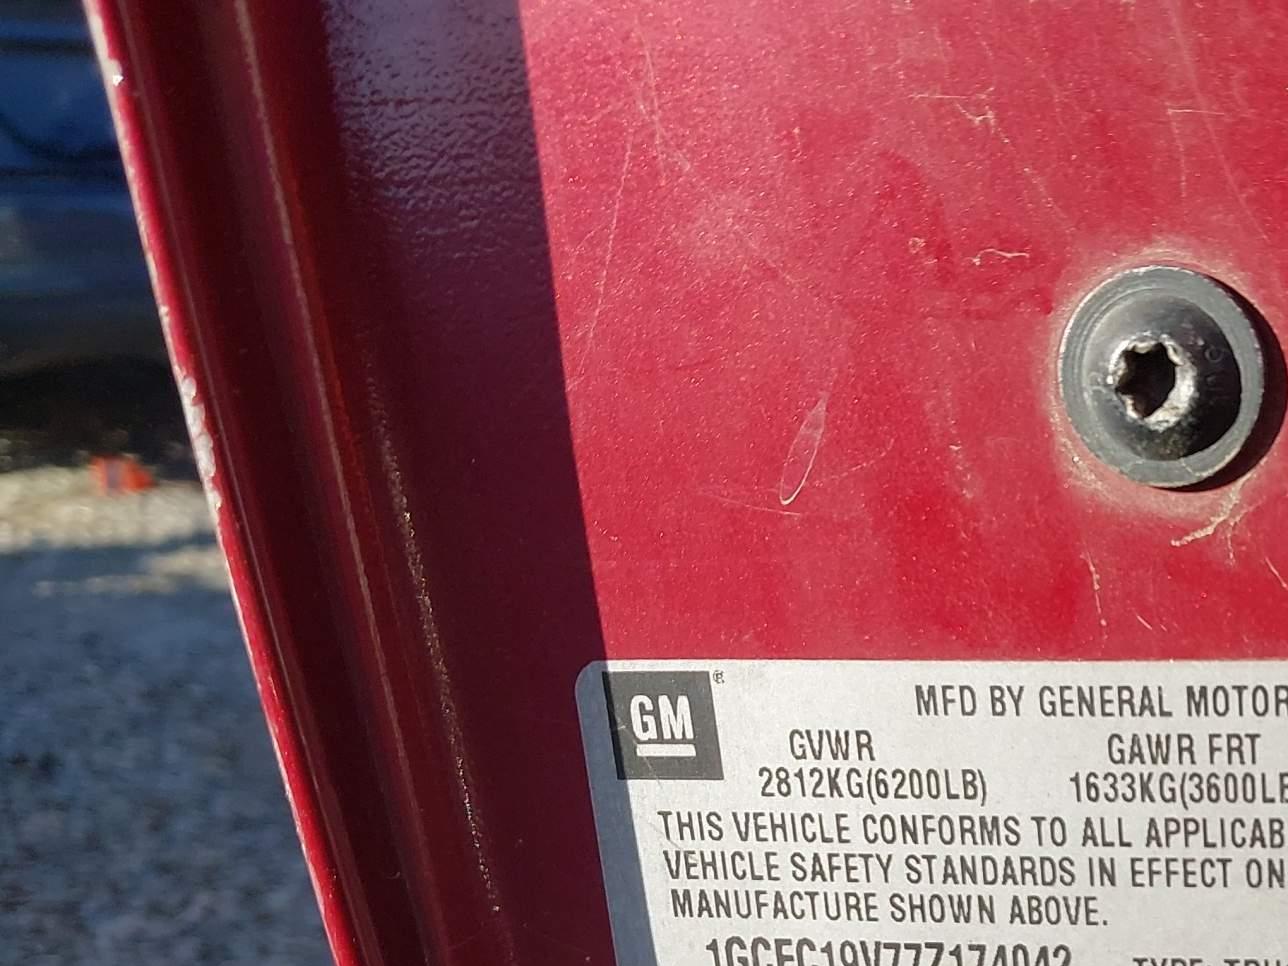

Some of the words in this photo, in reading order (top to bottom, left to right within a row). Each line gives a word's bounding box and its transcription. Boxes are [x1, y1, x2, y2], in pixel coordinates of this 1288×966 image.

[631, 695, 693, 740] GM
[915, 685, 976, 716] MFD
[990, 686, 1024, 716] BY
[1039, 686, 1172, 717] GENERAL
[789, 729, 875, 761] GVWR
[1108, 734, 1196, 765] GAWR
[1209, 734, 1261, 765] FRT
[759, 767, 986, 806] 2812KG(6200LB)
[657, 811, 723, 841] THIS
[732, 812, 850, 843] VEHICLE
[863, 814, 1020, 846] CONFORMS
[1031, 817, 1066, 846] TO
[1082, 817, 1132, 847] ALL
[663, 850, 780, 881] VEHICLE
[791, 852, 892, 883] SAFETY
[905, 855, 1075, 886] STANDARDS
[1089, 857, 1116, 886] IN
[1131, 858, 1232, 888] EFFECT
[1246, 858, 1284, 888] ON
[671, 889, 879, 921] MANUFACTURE
[889, 893, 995, 923] SHOWN
[1010, 895, 1107, 925] ABOVE.
